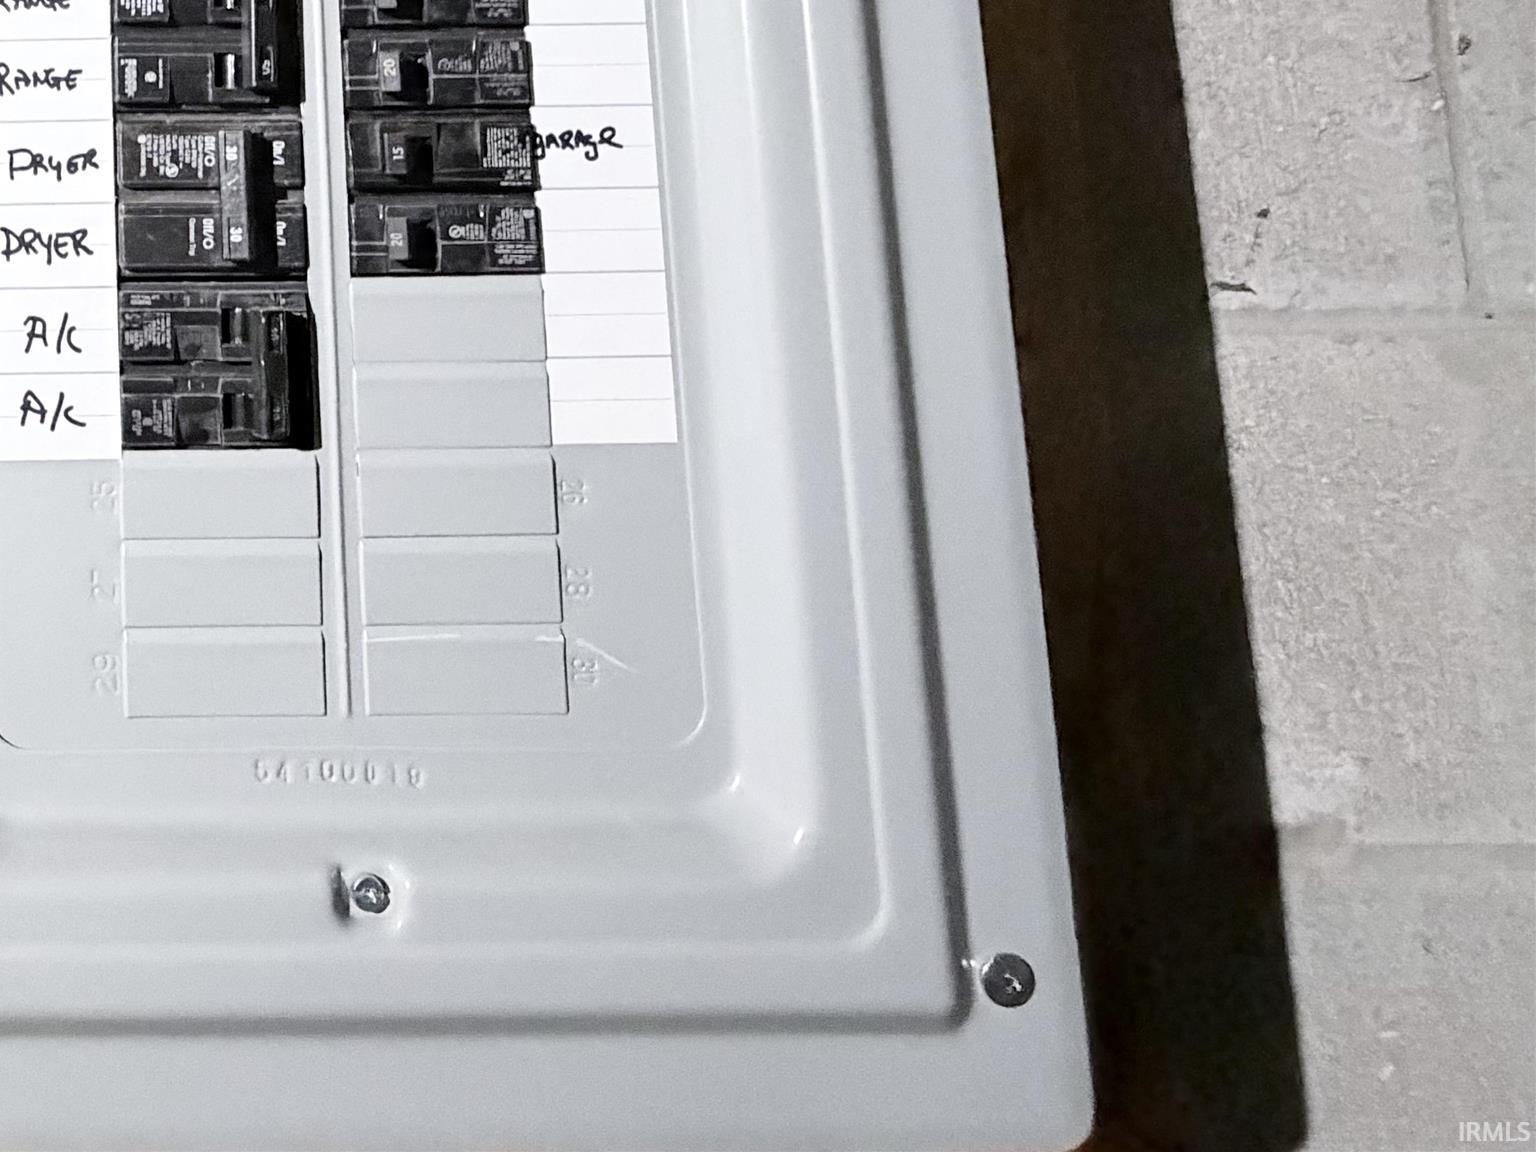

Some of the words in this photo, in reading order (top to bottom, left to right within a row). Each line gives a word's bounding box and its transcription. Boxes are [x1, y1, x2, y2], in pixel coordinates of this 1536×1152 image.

[383, 58, 396, 77] 20
[7, 148, 100, 181] DRYER
[0, 226, 94, 265] DRYER
[23, 312, 82, 354] A/C
[20, 389, 87, 432] A/C
